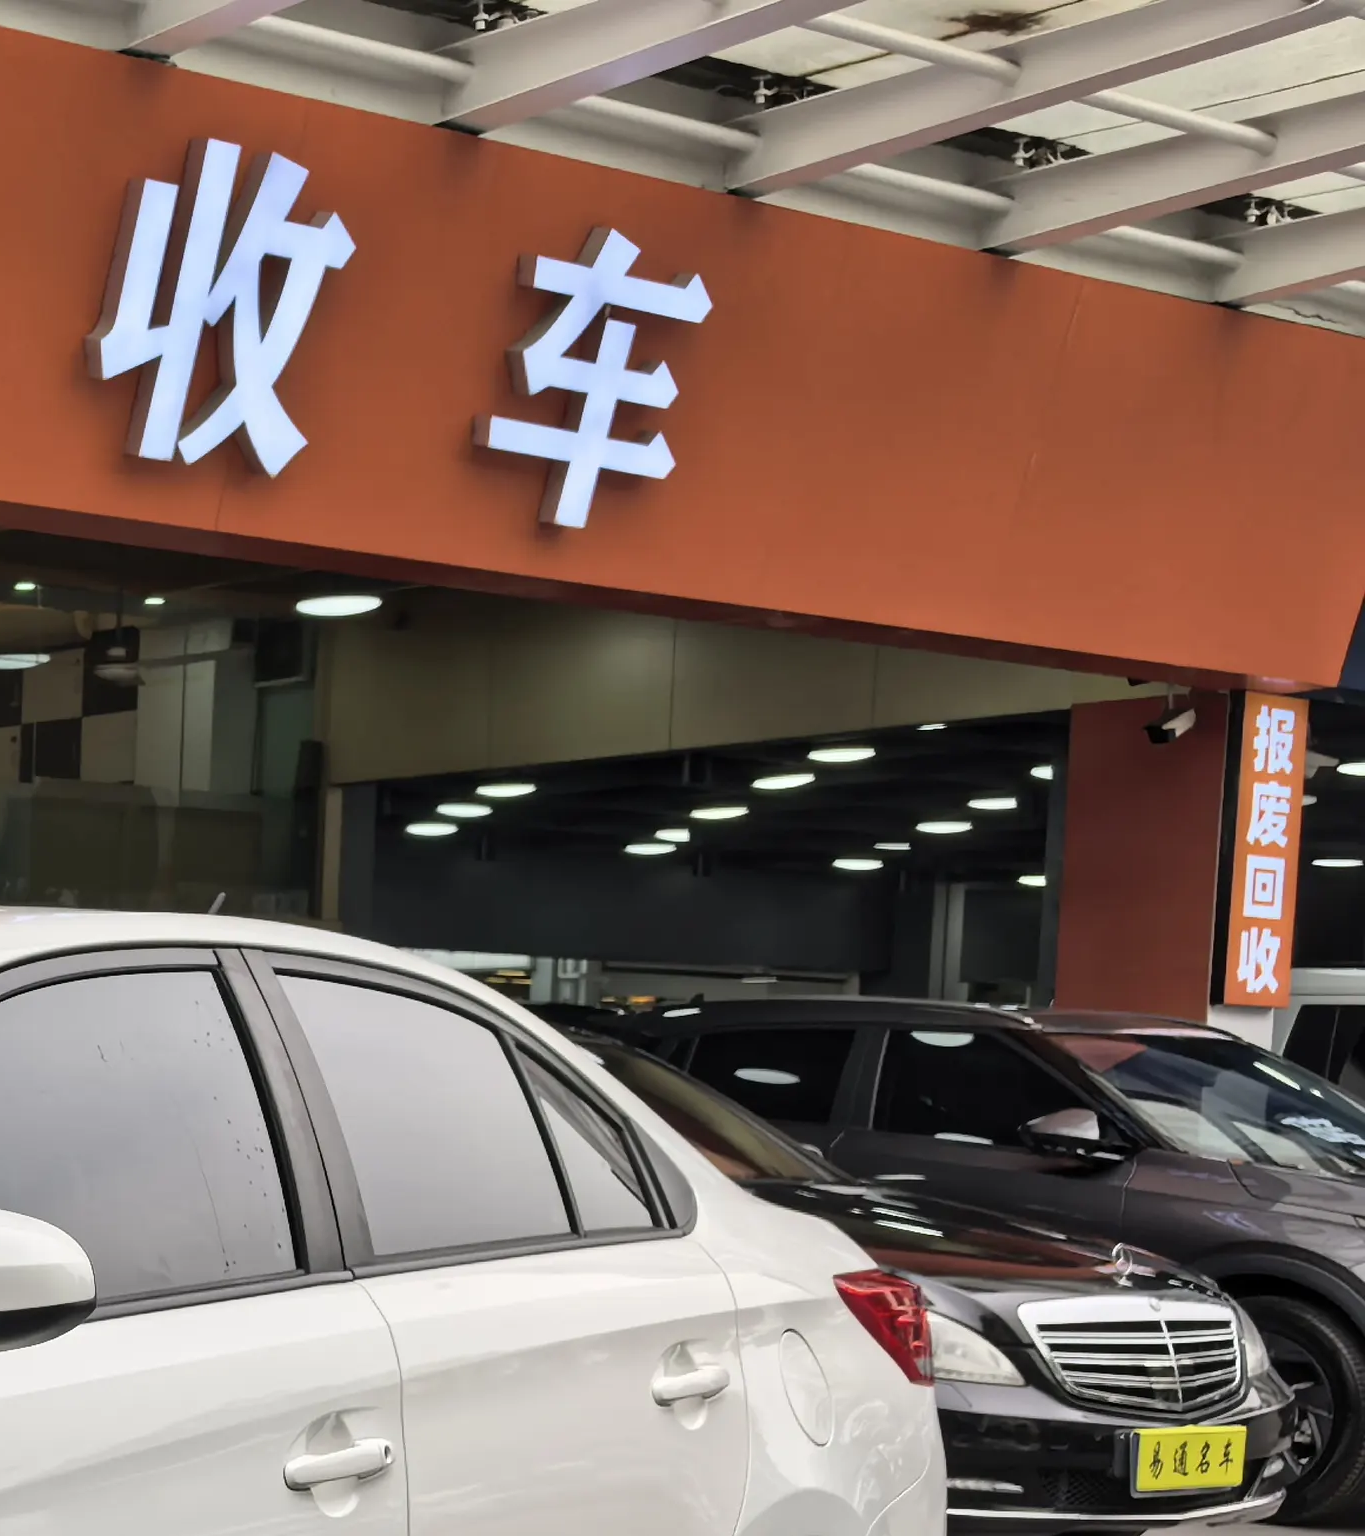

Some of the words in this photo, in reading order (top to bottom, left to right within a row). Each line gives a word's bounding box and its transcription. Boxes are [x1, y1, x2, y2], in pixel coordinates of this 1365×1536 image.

[1237, 704, 1296, 994] 报废回收
[1148, 1437, 1235, 1479] 易通名车
